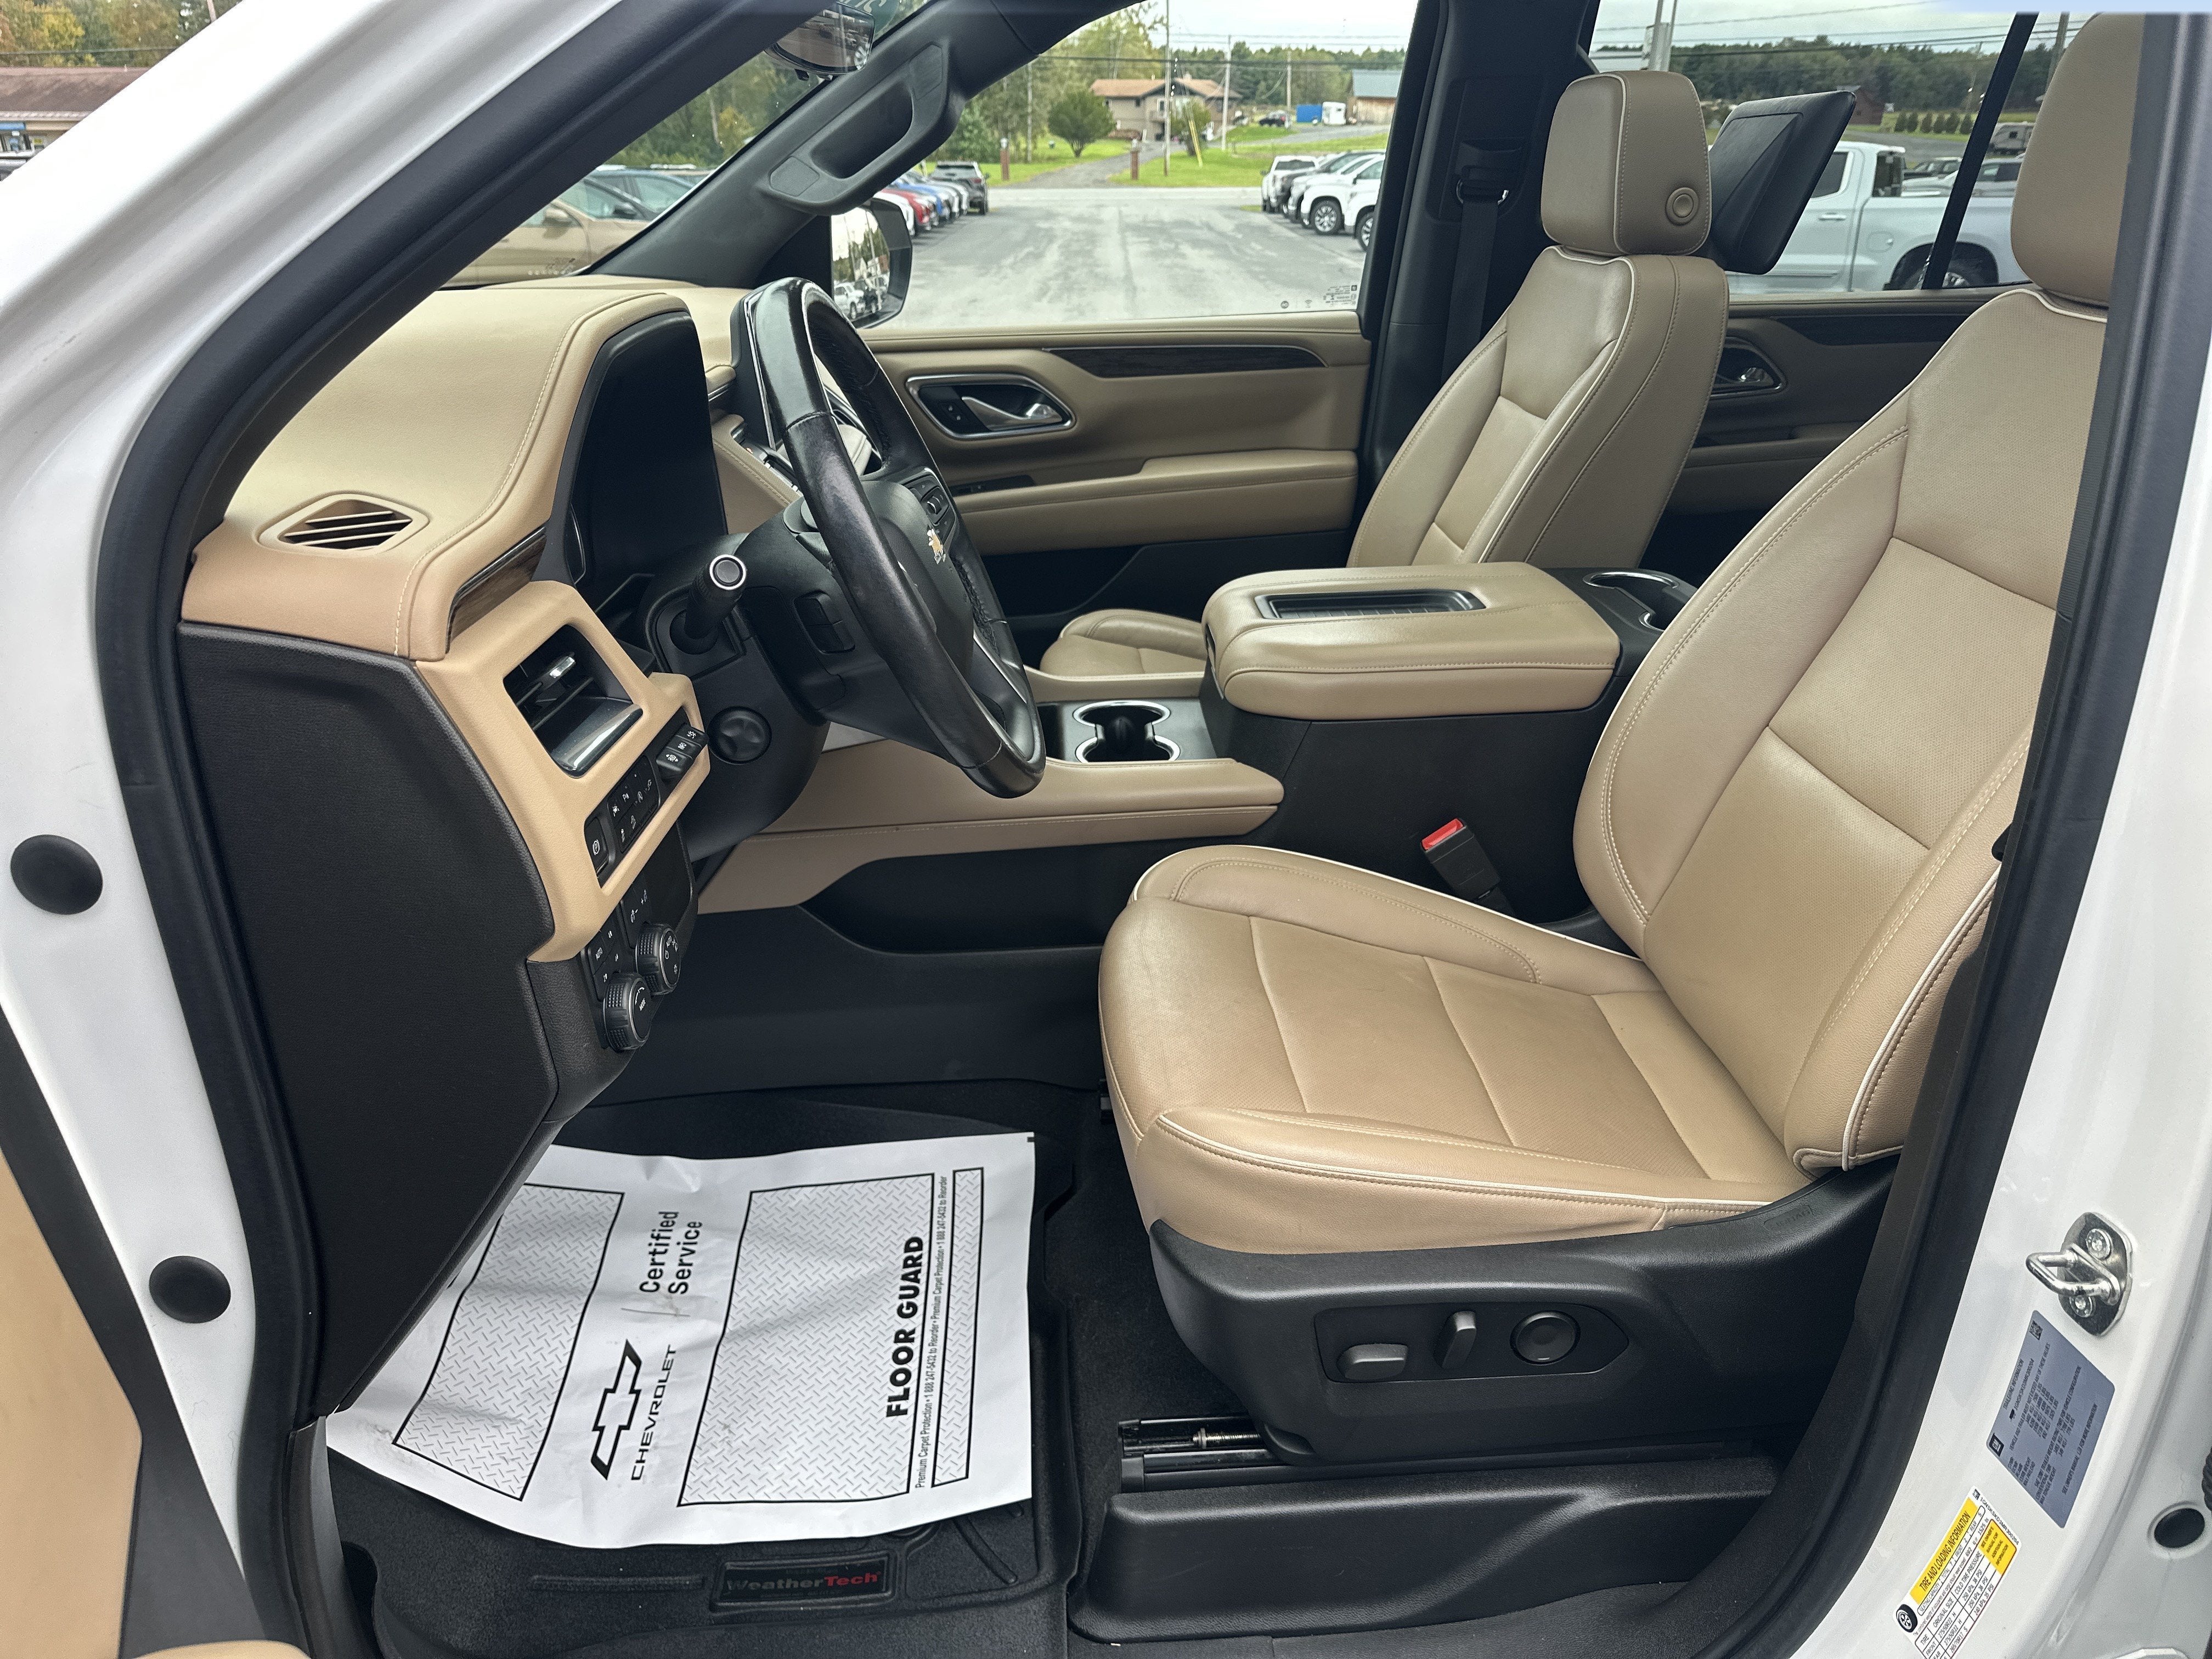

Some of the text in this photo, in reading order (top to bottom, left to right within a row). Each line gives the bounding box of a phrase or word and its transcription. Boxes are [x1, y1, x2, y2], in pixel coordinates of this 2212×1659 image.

[937, 1176, 947, 1198] Reorder
[639, 1211, 679, 1293] Certified
[668, 1221, 703, 1294] Service
[933, 1249, 944, 1276] Protection
[932, 1277, 944, 1294] Carpet
[930, 1296, 941, 1319] Premium
[886, 1237, 923, 1417] FLOOR GUARD
[927, 1324, 939, 1346] Reorder
[924, 1355, 936, 1380] 247-5432
[2011, 1358, 2024, 1387] INFORMATION
[631, 1344, 676, 1480] CHEVROLET
[920, 1402, 932, 1434] Protection
[918, 1436, 931, 1457] Carpet
[915, 1459, 927, 1487] Premium
[1969, 1520, 1977, 1532] REAR
[1977, 1522, 1987, 1536] 1525
[1919, 1510, 1972, 1593] TIRE AND LOADING INFORMATION
[1954, 1544, 1963, 1557] FRONT
[1985, 1538, 1995, 1553] MANUAL
[1941, 1567, 1949, 1579] TOTAL
[1954, 1550, 1982, 1595] COLD TIRE PRESSURE
[1919, 1582, 1940, 1613] SEATING CAPACITY
[1932, 1597, 1954, 1629] ORIGINAL SIZE
[1920, 1633, 1929, 1646] TIRE
[1925, 1640, 1937, 1656] FRONT
